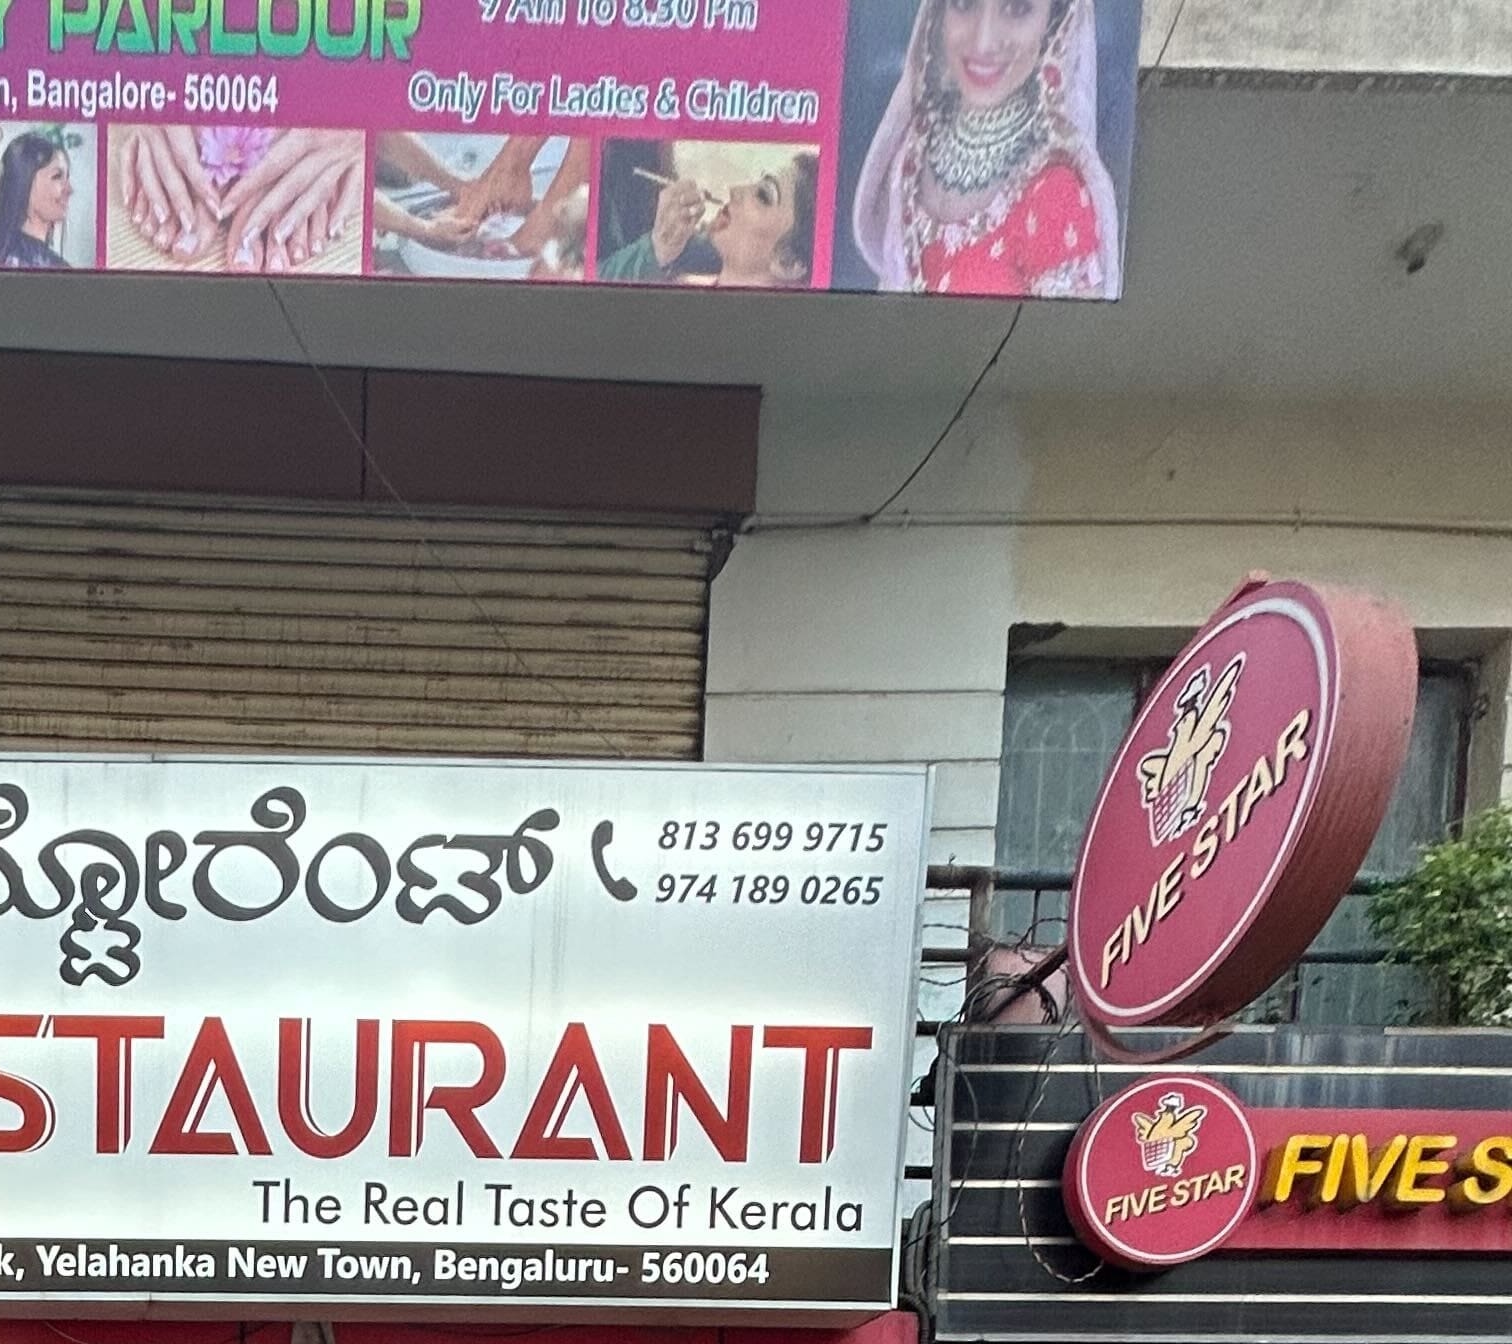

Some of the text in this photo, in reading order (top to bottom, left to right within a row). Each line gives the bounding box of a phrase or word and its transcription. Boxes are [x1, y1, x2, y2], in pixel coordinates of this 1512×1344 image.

[27, 68, 177, 119] Bangalore-
[184, 71, 279, 115] 560064
[409, 70, 820, 124] Only For Ladies & Children
[657, 819, 889, 854] 813 699 9715
[1100, 708, 1311, 989] FIVE STAR
[653, 873, 883, 907] 974 189 0265
[1103, 1162, 1246, 1225] FIVE STAR
[1274, 1132, 1458, 1203] FIVE
[252, 1180, 865, 1233] The Real Taste Of Kerala
[36, 1244, 217, 1281] Yelahanka
[226, 1247, 308, 1281] New
[317, 1248, 422, 1285] Town,
[433, 1249, 629, 1289] Bengaluru-
[639, 1251, 770, 1285] 560064
